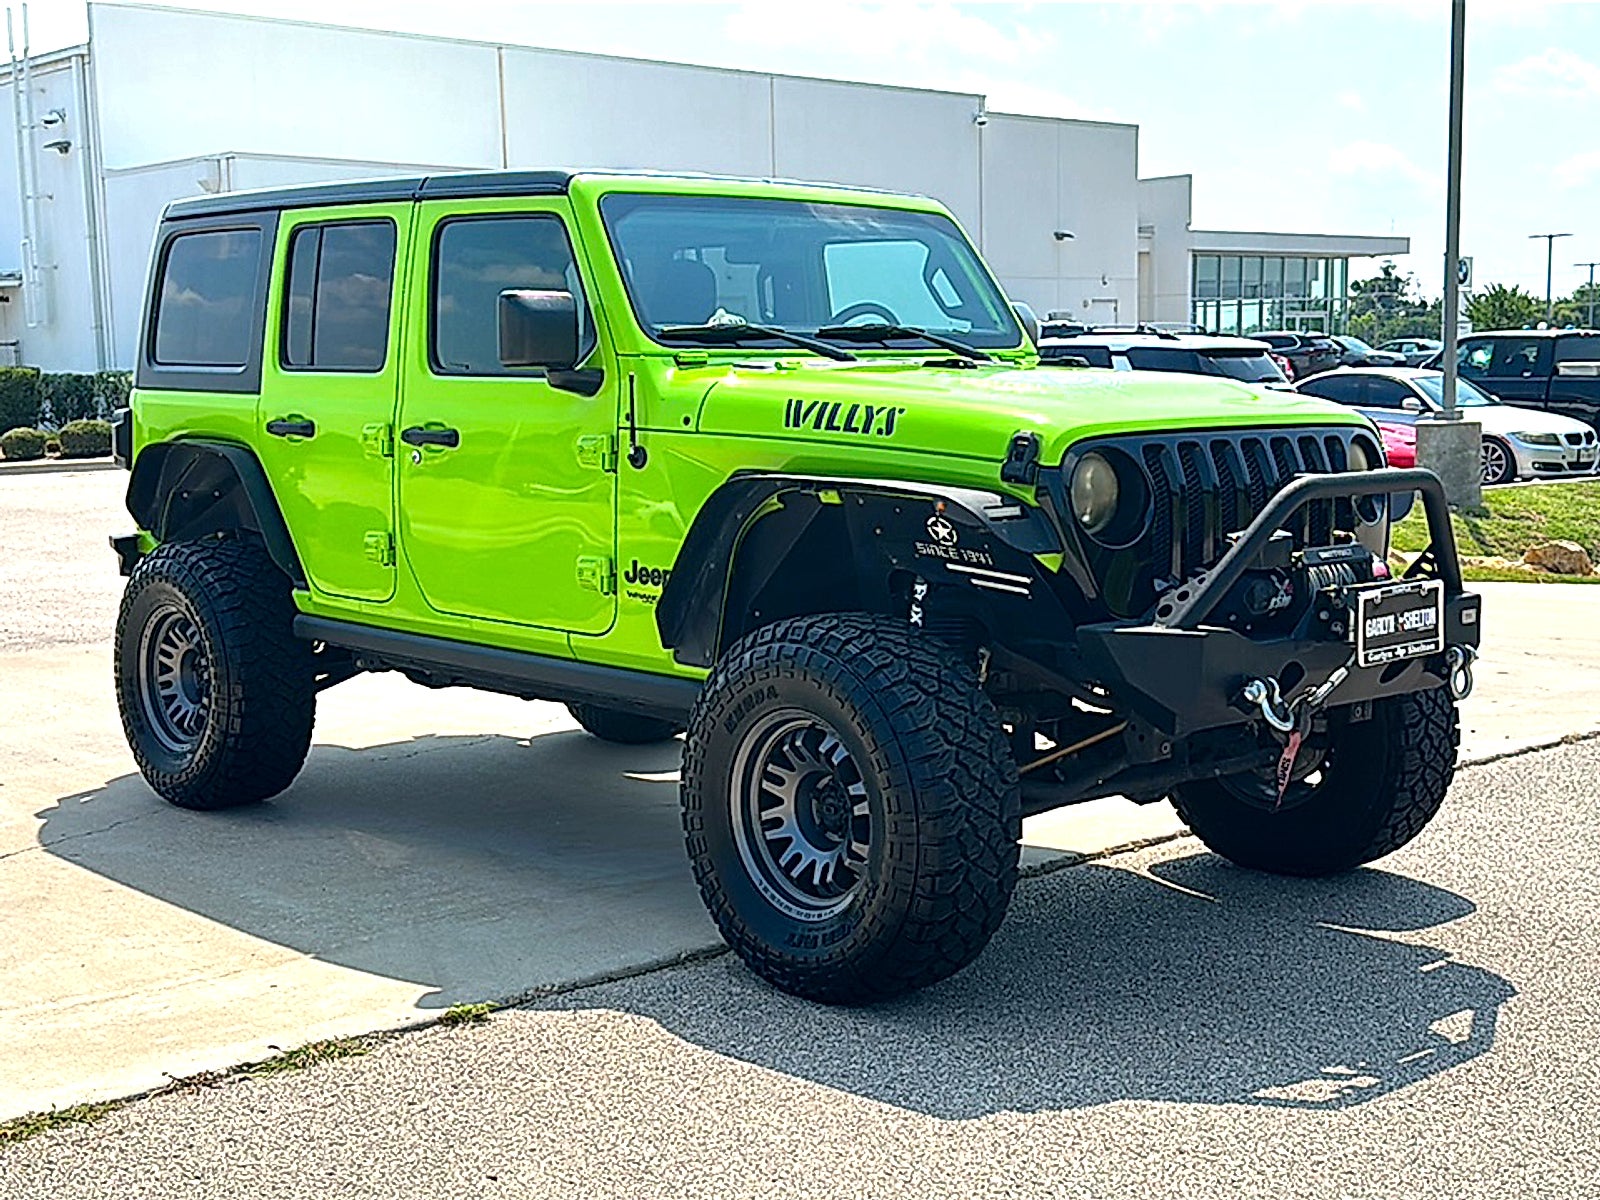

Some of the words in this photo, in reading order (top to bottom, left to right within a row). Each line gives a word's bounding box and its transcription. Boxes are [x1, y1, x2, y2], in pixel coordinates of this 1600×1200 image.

[785, 399, 905, 435] WILLYS
[915, 542, 959, 559] SINCE
[960, 549, 993, 565] 1941
